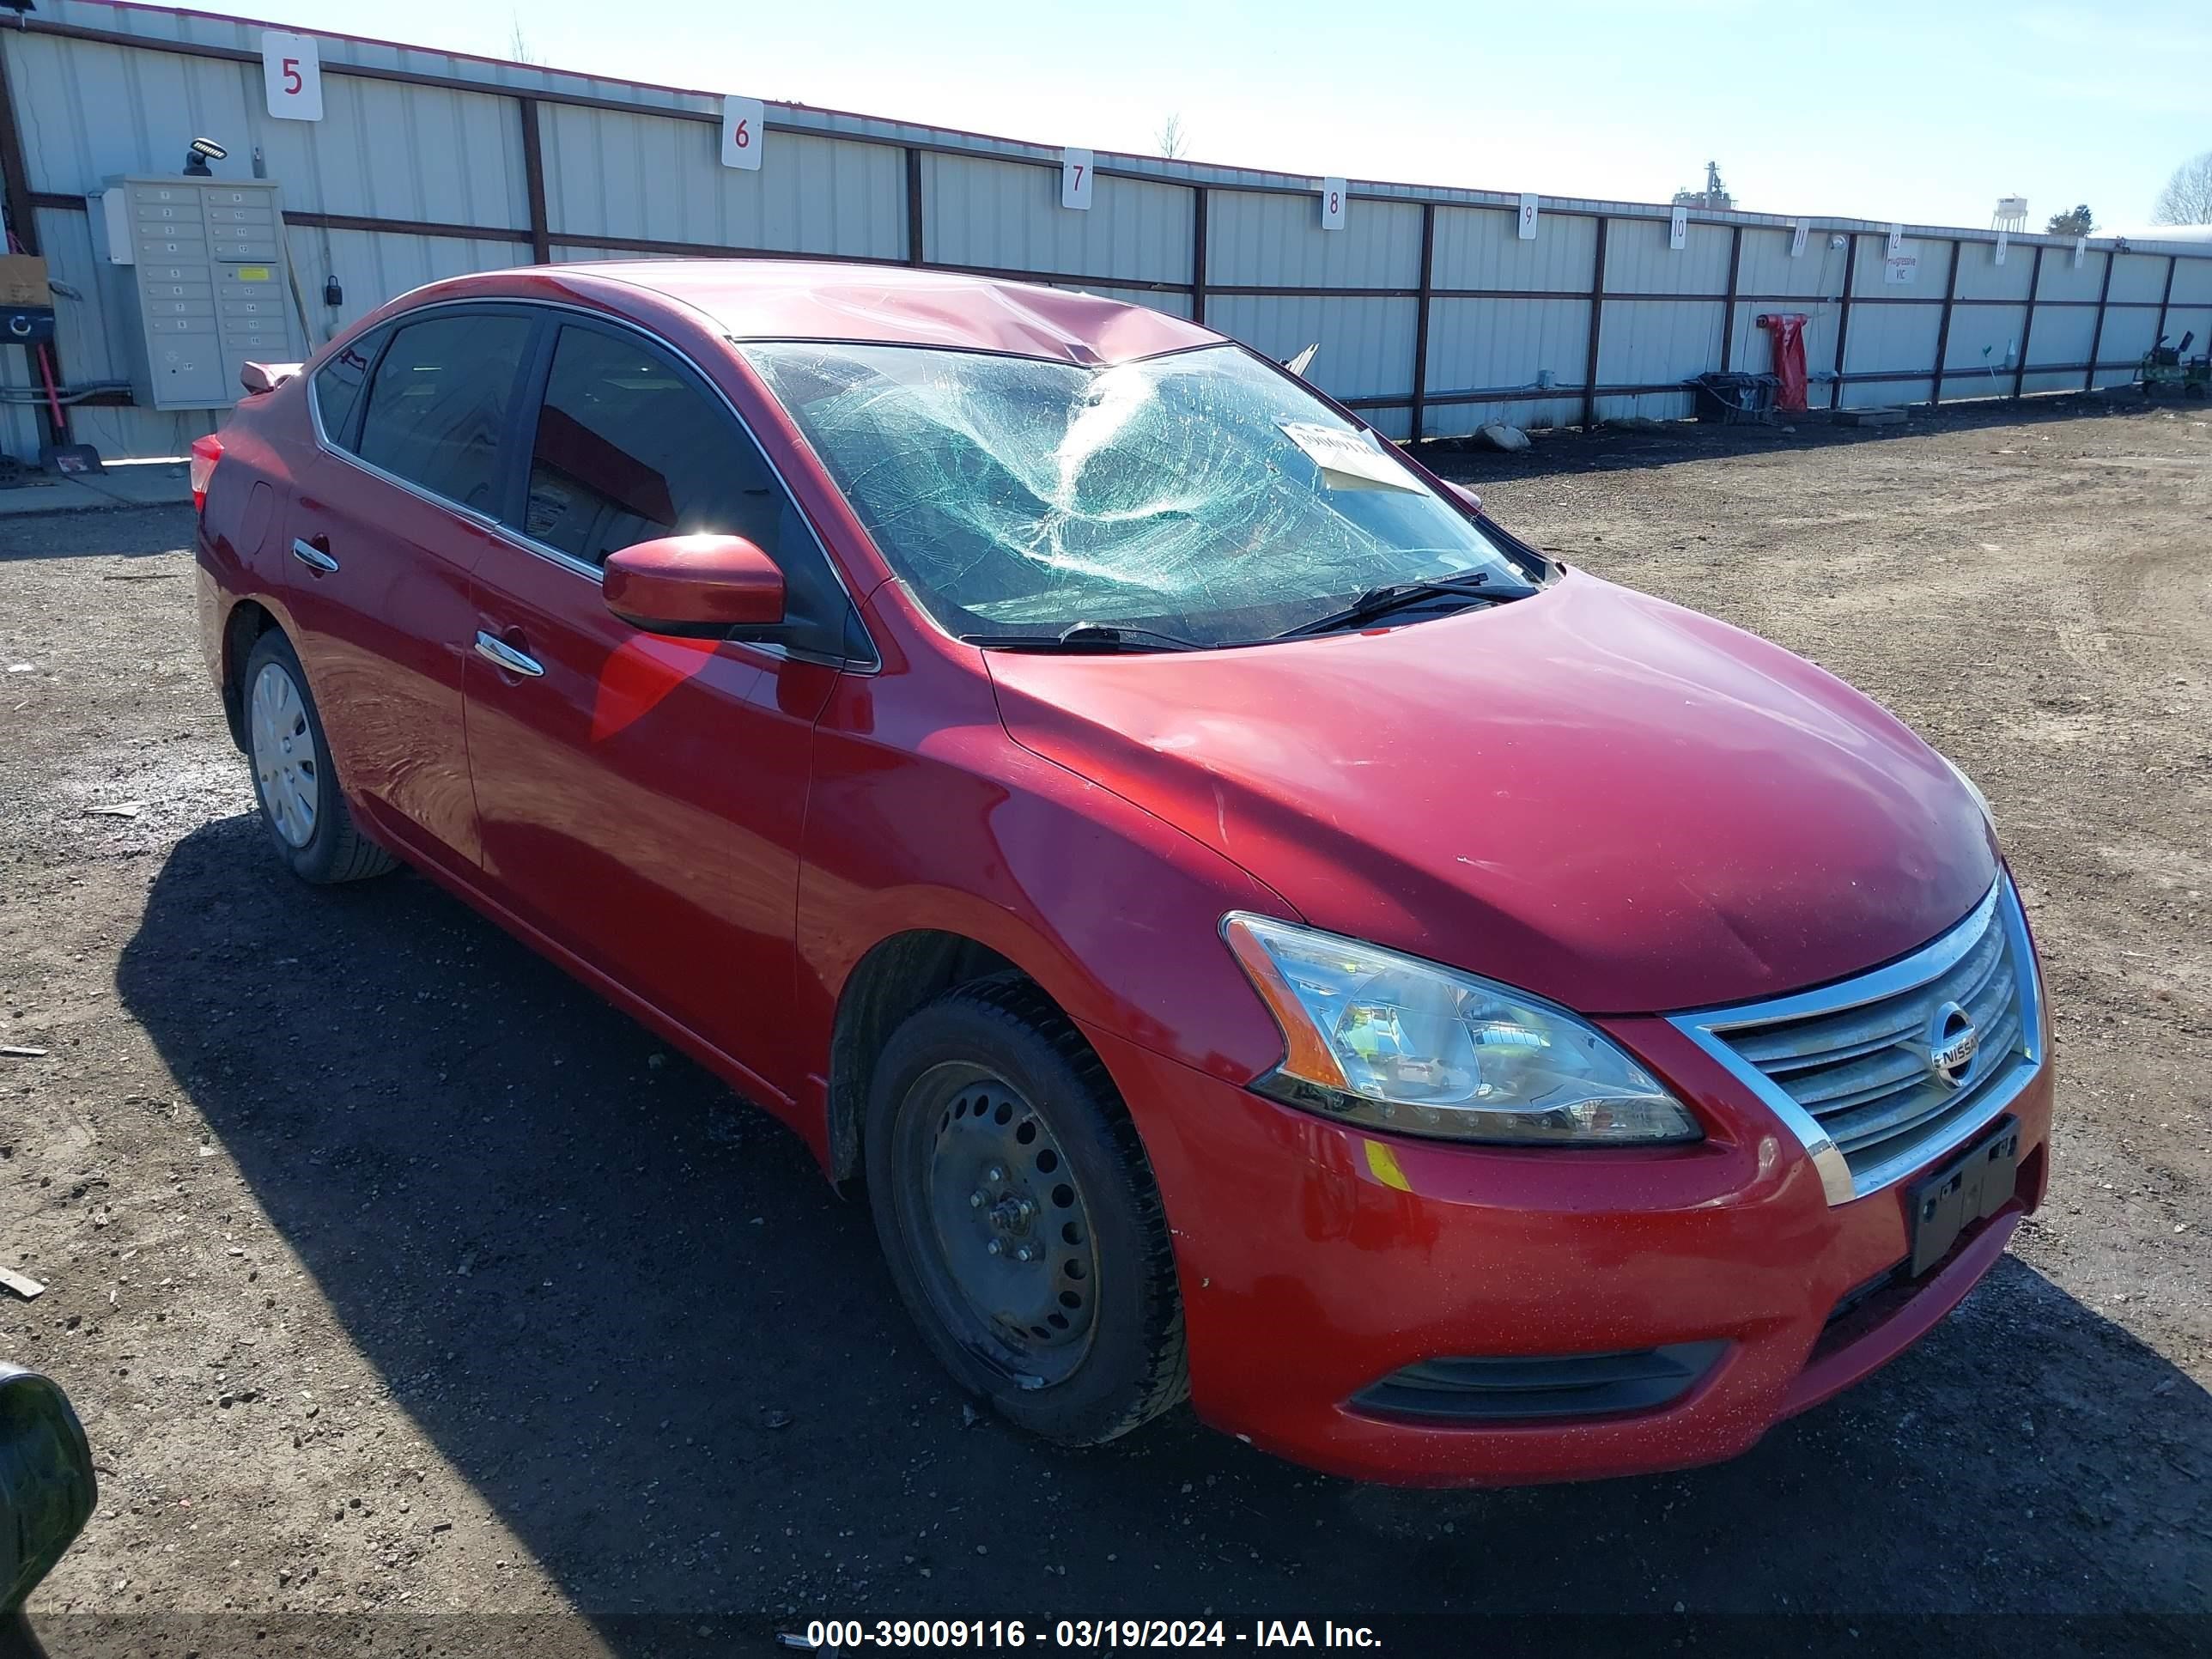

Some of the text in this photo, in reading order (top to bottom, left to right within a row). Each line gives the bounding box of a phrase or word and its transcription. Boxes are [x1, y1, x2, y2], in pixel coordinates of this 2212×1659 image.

[282, 58, 303, 95] 5
[735, 118, 750, 149] 6
[1073, 164, 1084, 191] 7
[1329, 191, 1339, 215] 8
[1525, 205, 1533, 225] 9
[1674, 219, 1684, 237] 10
[1796, 228, 1805, 247] 11
[1890, 233, 1899, 249] 12
